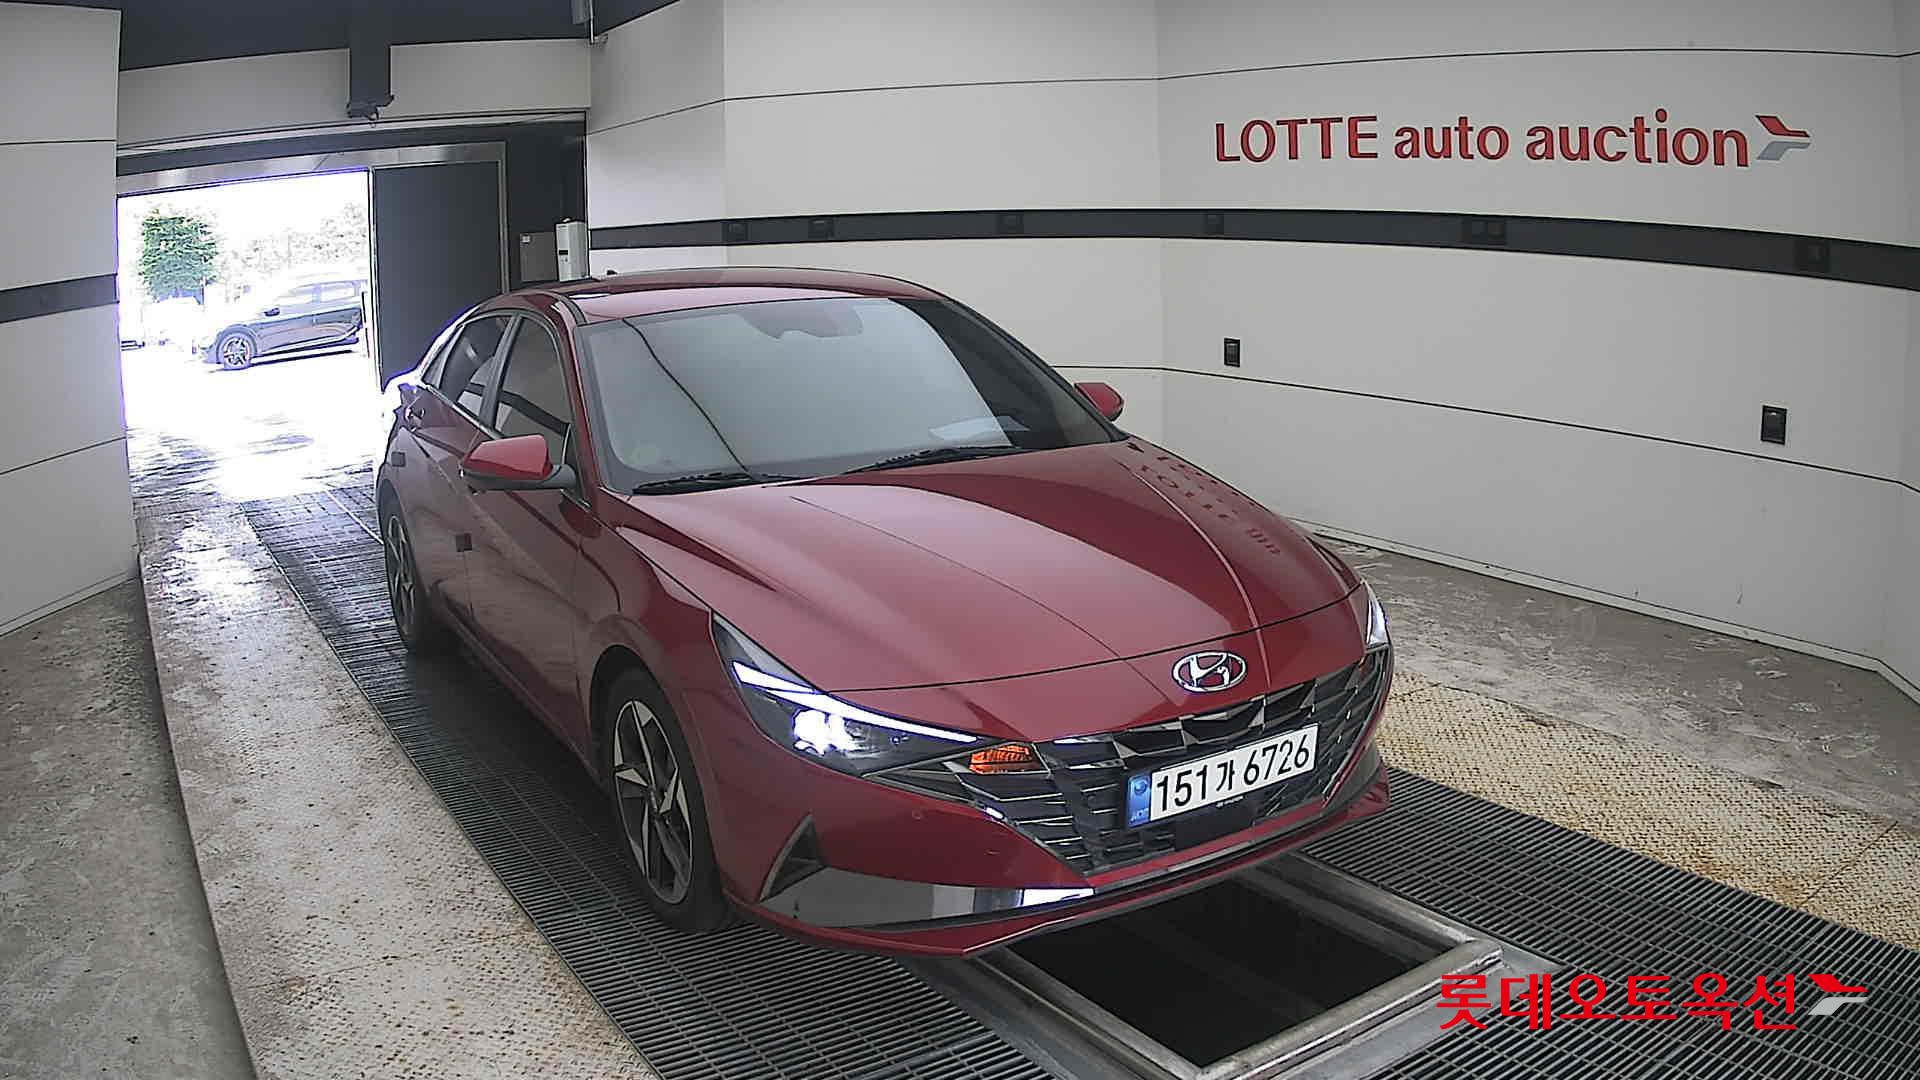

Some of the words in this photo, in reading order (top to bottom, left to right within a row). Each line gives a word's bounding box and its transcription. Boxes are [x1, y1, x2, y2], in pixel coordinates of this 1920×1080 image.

[1215, 115, 1378, 162] LOTTE
[1394, 116, 1510, 160] auto
[1526, 109, 1749, 167] auction
[1155, 758, 1236, 812] 151가
[1243, 734, 1310, 785] 6726
